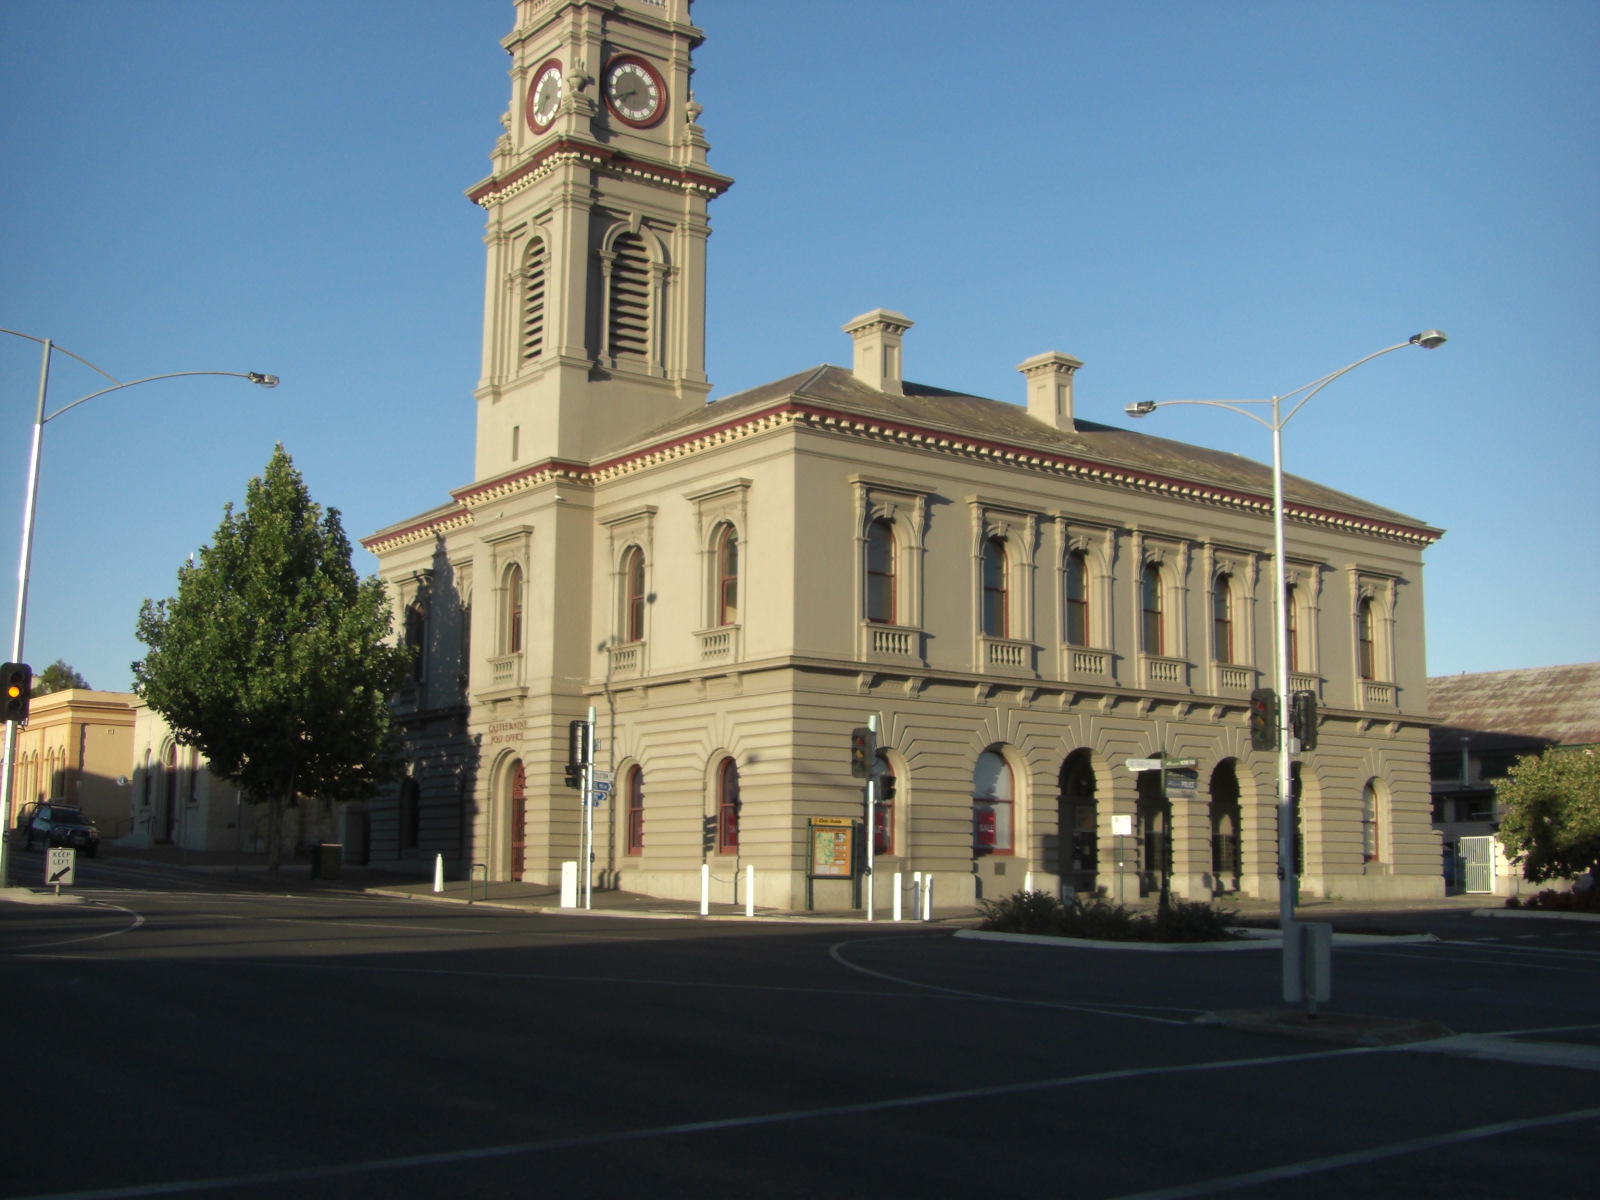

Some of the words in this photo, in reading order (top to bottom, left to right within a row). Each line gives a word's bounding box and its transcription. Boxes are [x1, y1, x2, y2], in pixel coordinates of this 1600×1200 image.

[489, 720, 527, 733] CASTLEMAINE
[491, 735, 503, 744] POST
[506, 733, 524, 743] OFFICE
